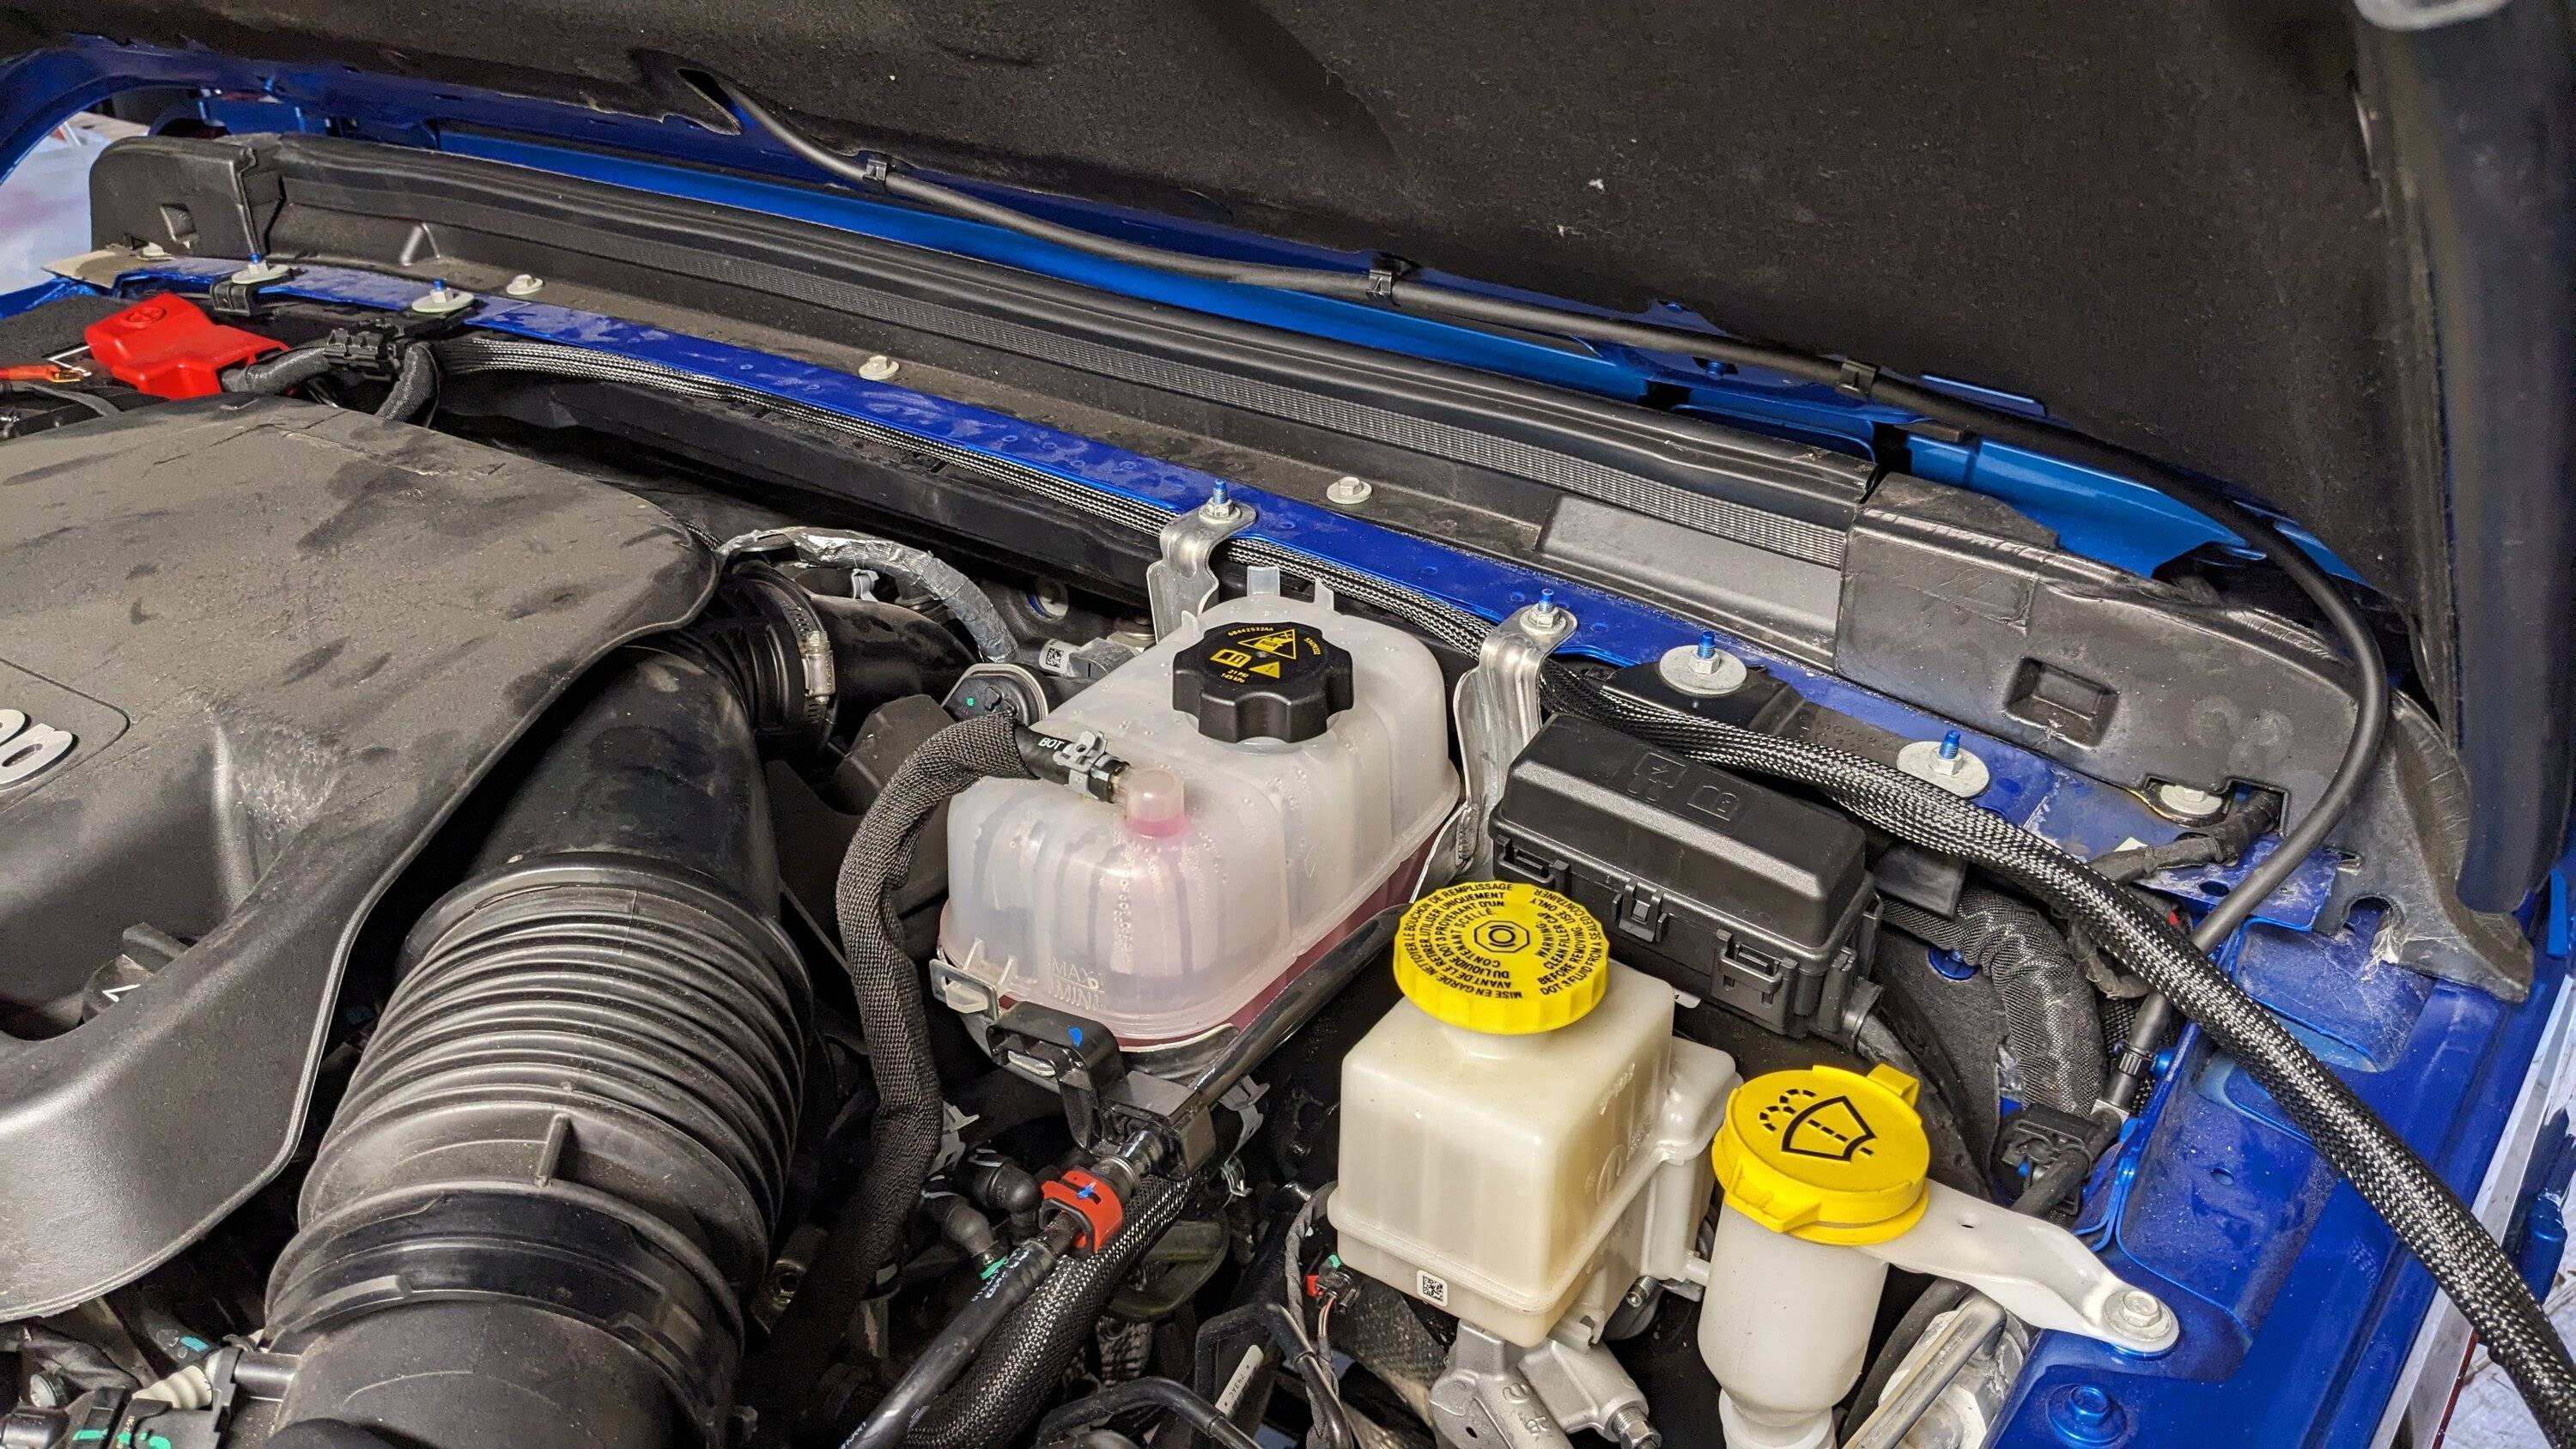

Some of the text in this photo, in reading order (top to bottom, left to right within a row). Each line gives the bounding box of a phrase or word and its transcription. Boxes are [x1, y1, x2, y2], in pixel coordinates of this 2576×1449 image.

[1037, 737, 1066, 750] BOT
[1443, 883, 1512, 898] REMPLISSAGE
[1428, 895, 1443, 905] DE
[1439, 892, 1504, 911] UNIQUEMENT
[1529, 897, 1558, 912] ONLY
[1404, 902, 1431, 931] BOUCHON
[1419, 908, 1440, 936] UTILISER
[1435, 902, 1476, 936] PROVENANT
[1555, 910, 1576, 925] USE
[1580, 915, 1601, 941] SEALED
[1537, 912, 1571, 970] CLEAN FILLER CAP
[1437, 943, 1455, 957] DOT
[1450, 930, 1501, 968] CONTENANT
[1585, 947, 1602, 967] FROM
[1443, 965, 1459, 975] LE
[1449, 955, 1492, 977] LIQUIDE
[1537, 962, 1577, 985] BEFORE
[1456, 972, 1473, 982] DE
[1493, 970, 1510, 979] DU
[1567, 966, 1593, 984] FLUID
[1473, 978, 1511, 989] AVANT
[1540, 983, 1563, 996] DOT
[1476, 988, 1492, 997] EN
[1496, 991, 1523, 999] MISE
